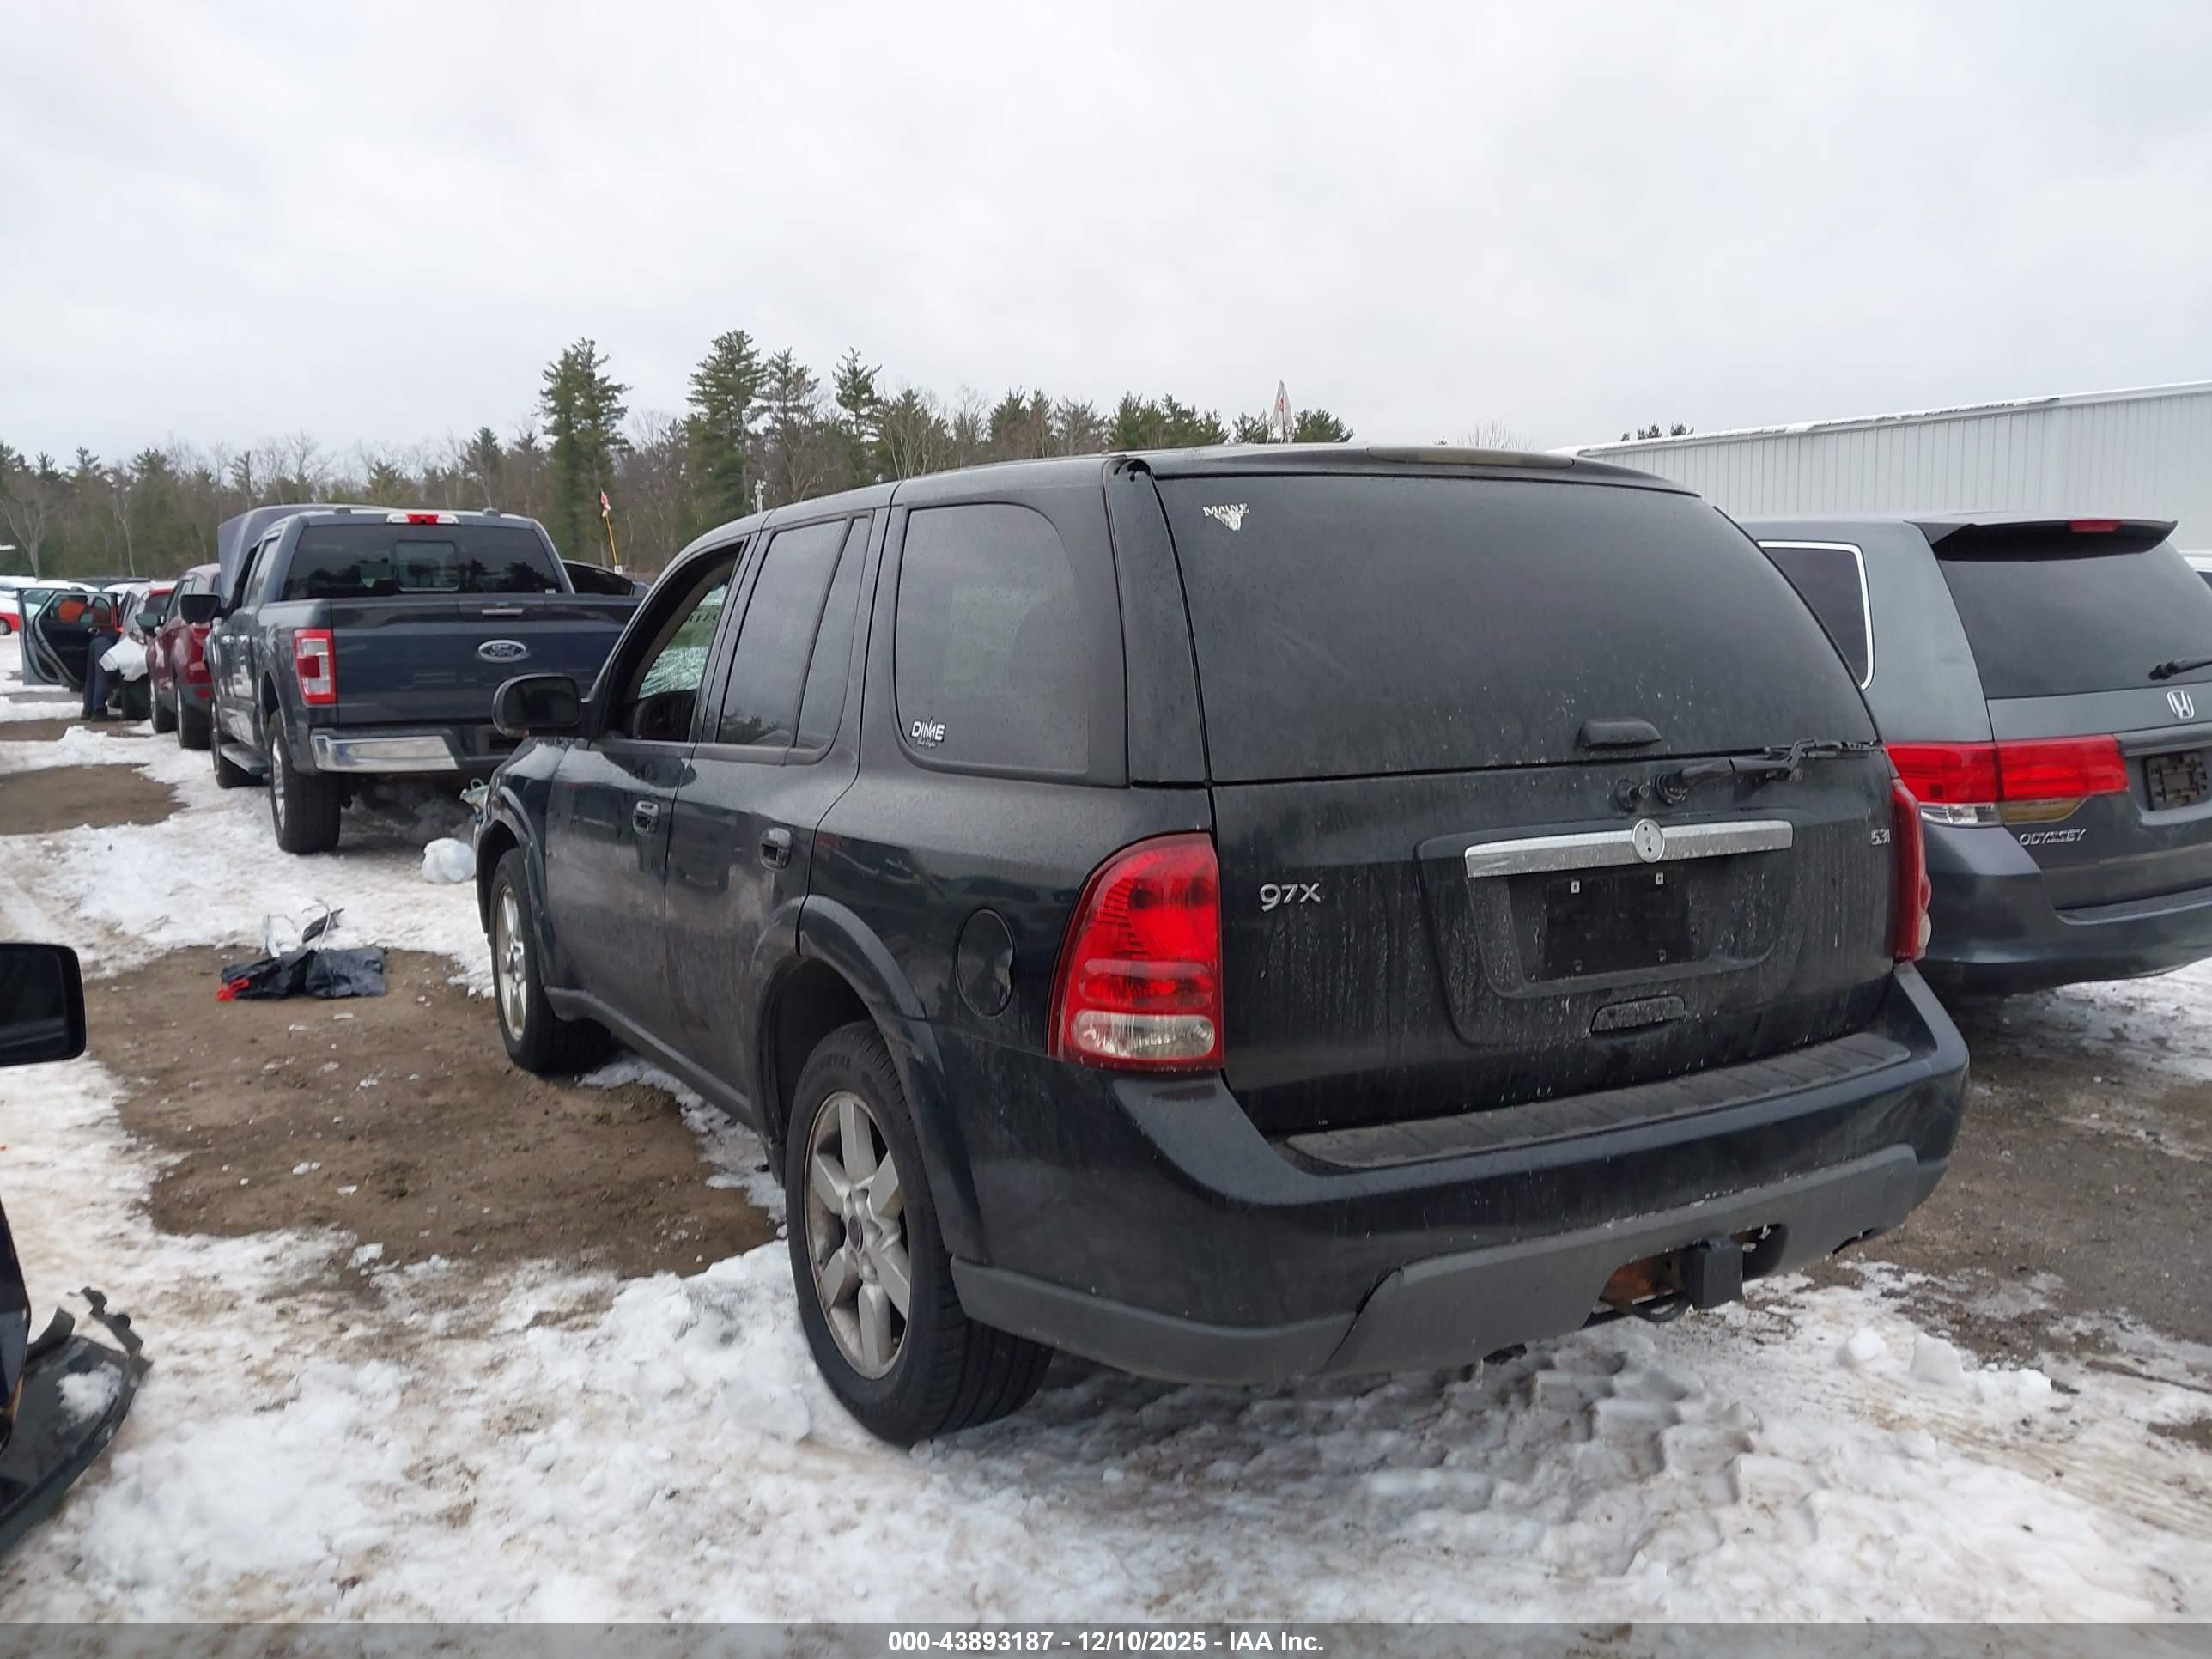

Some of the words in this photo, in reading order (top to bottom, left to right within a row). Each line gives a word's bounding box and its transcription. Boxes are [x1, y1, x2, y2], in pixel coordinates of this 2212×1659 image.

[911, 720, 945, 741] DIME
[2019, 828, 2087, 846] ODYSSEY
[1260, 882, 1322, 912] 97X
